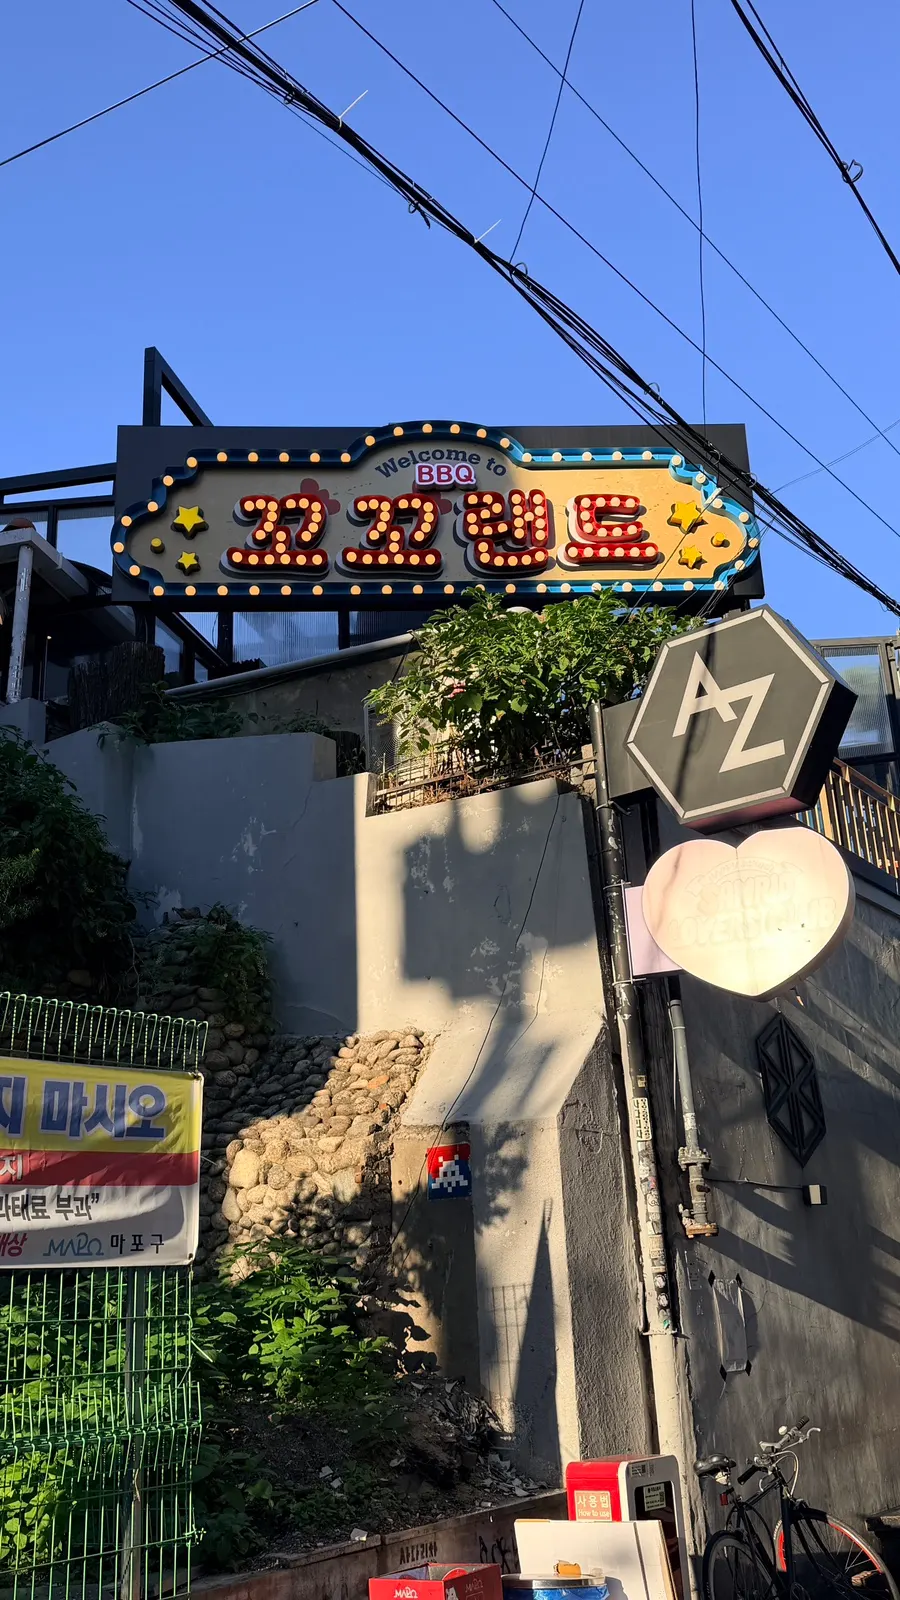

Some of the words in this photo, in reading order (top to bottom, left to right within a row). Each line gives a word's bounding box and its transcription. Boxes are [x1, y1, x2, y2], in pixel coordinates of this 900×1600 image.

[375, 449, 481, 478] Welcome
[486, 457, 507, 477] to
[416, 463, 476, 484] BBQ
[226, 489, 660, 569] 꼬꼬랜드
[672, 650, 786, 774] AZ
[40, 1079, 166, 1139] 마시오
[577, 1495, 609, 1509] 사용법
[578, 1509, 591, 1517] How
[592, 1509, 599, 1517] to
[600, 1510, 610, 1518] use
